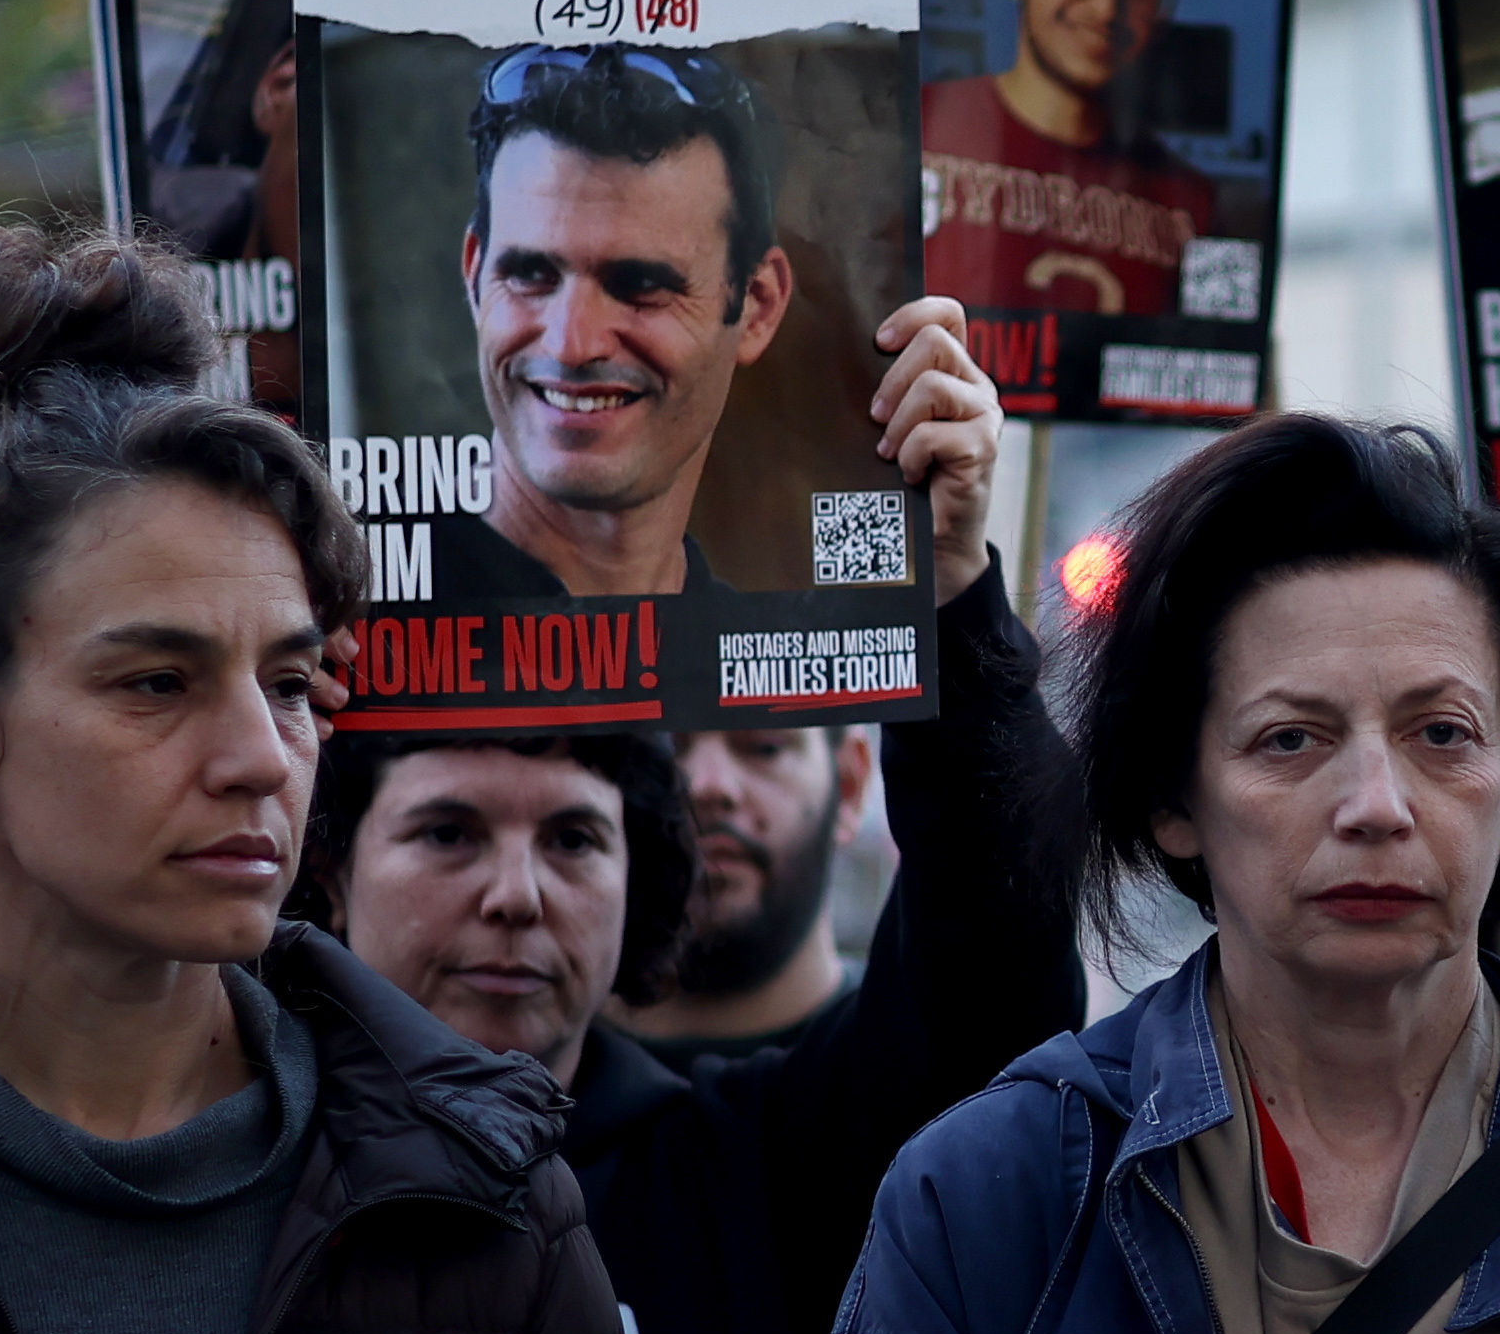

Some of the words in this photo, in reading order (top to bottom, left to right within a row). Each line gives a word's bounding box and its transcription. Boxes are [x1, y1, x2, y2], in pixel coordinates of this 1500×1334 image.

[329, 433, 492, 515] BRING
[503, 600, 658, 693] NOW!
[719, 631, 804, 660] HOSTAGES
[806, 630, 841, 657] AND
[843, 626, 916, 655] MISSING
[720, 658, 828, 698] FAMILIES
[833, 652, 917, 694] FORUM
